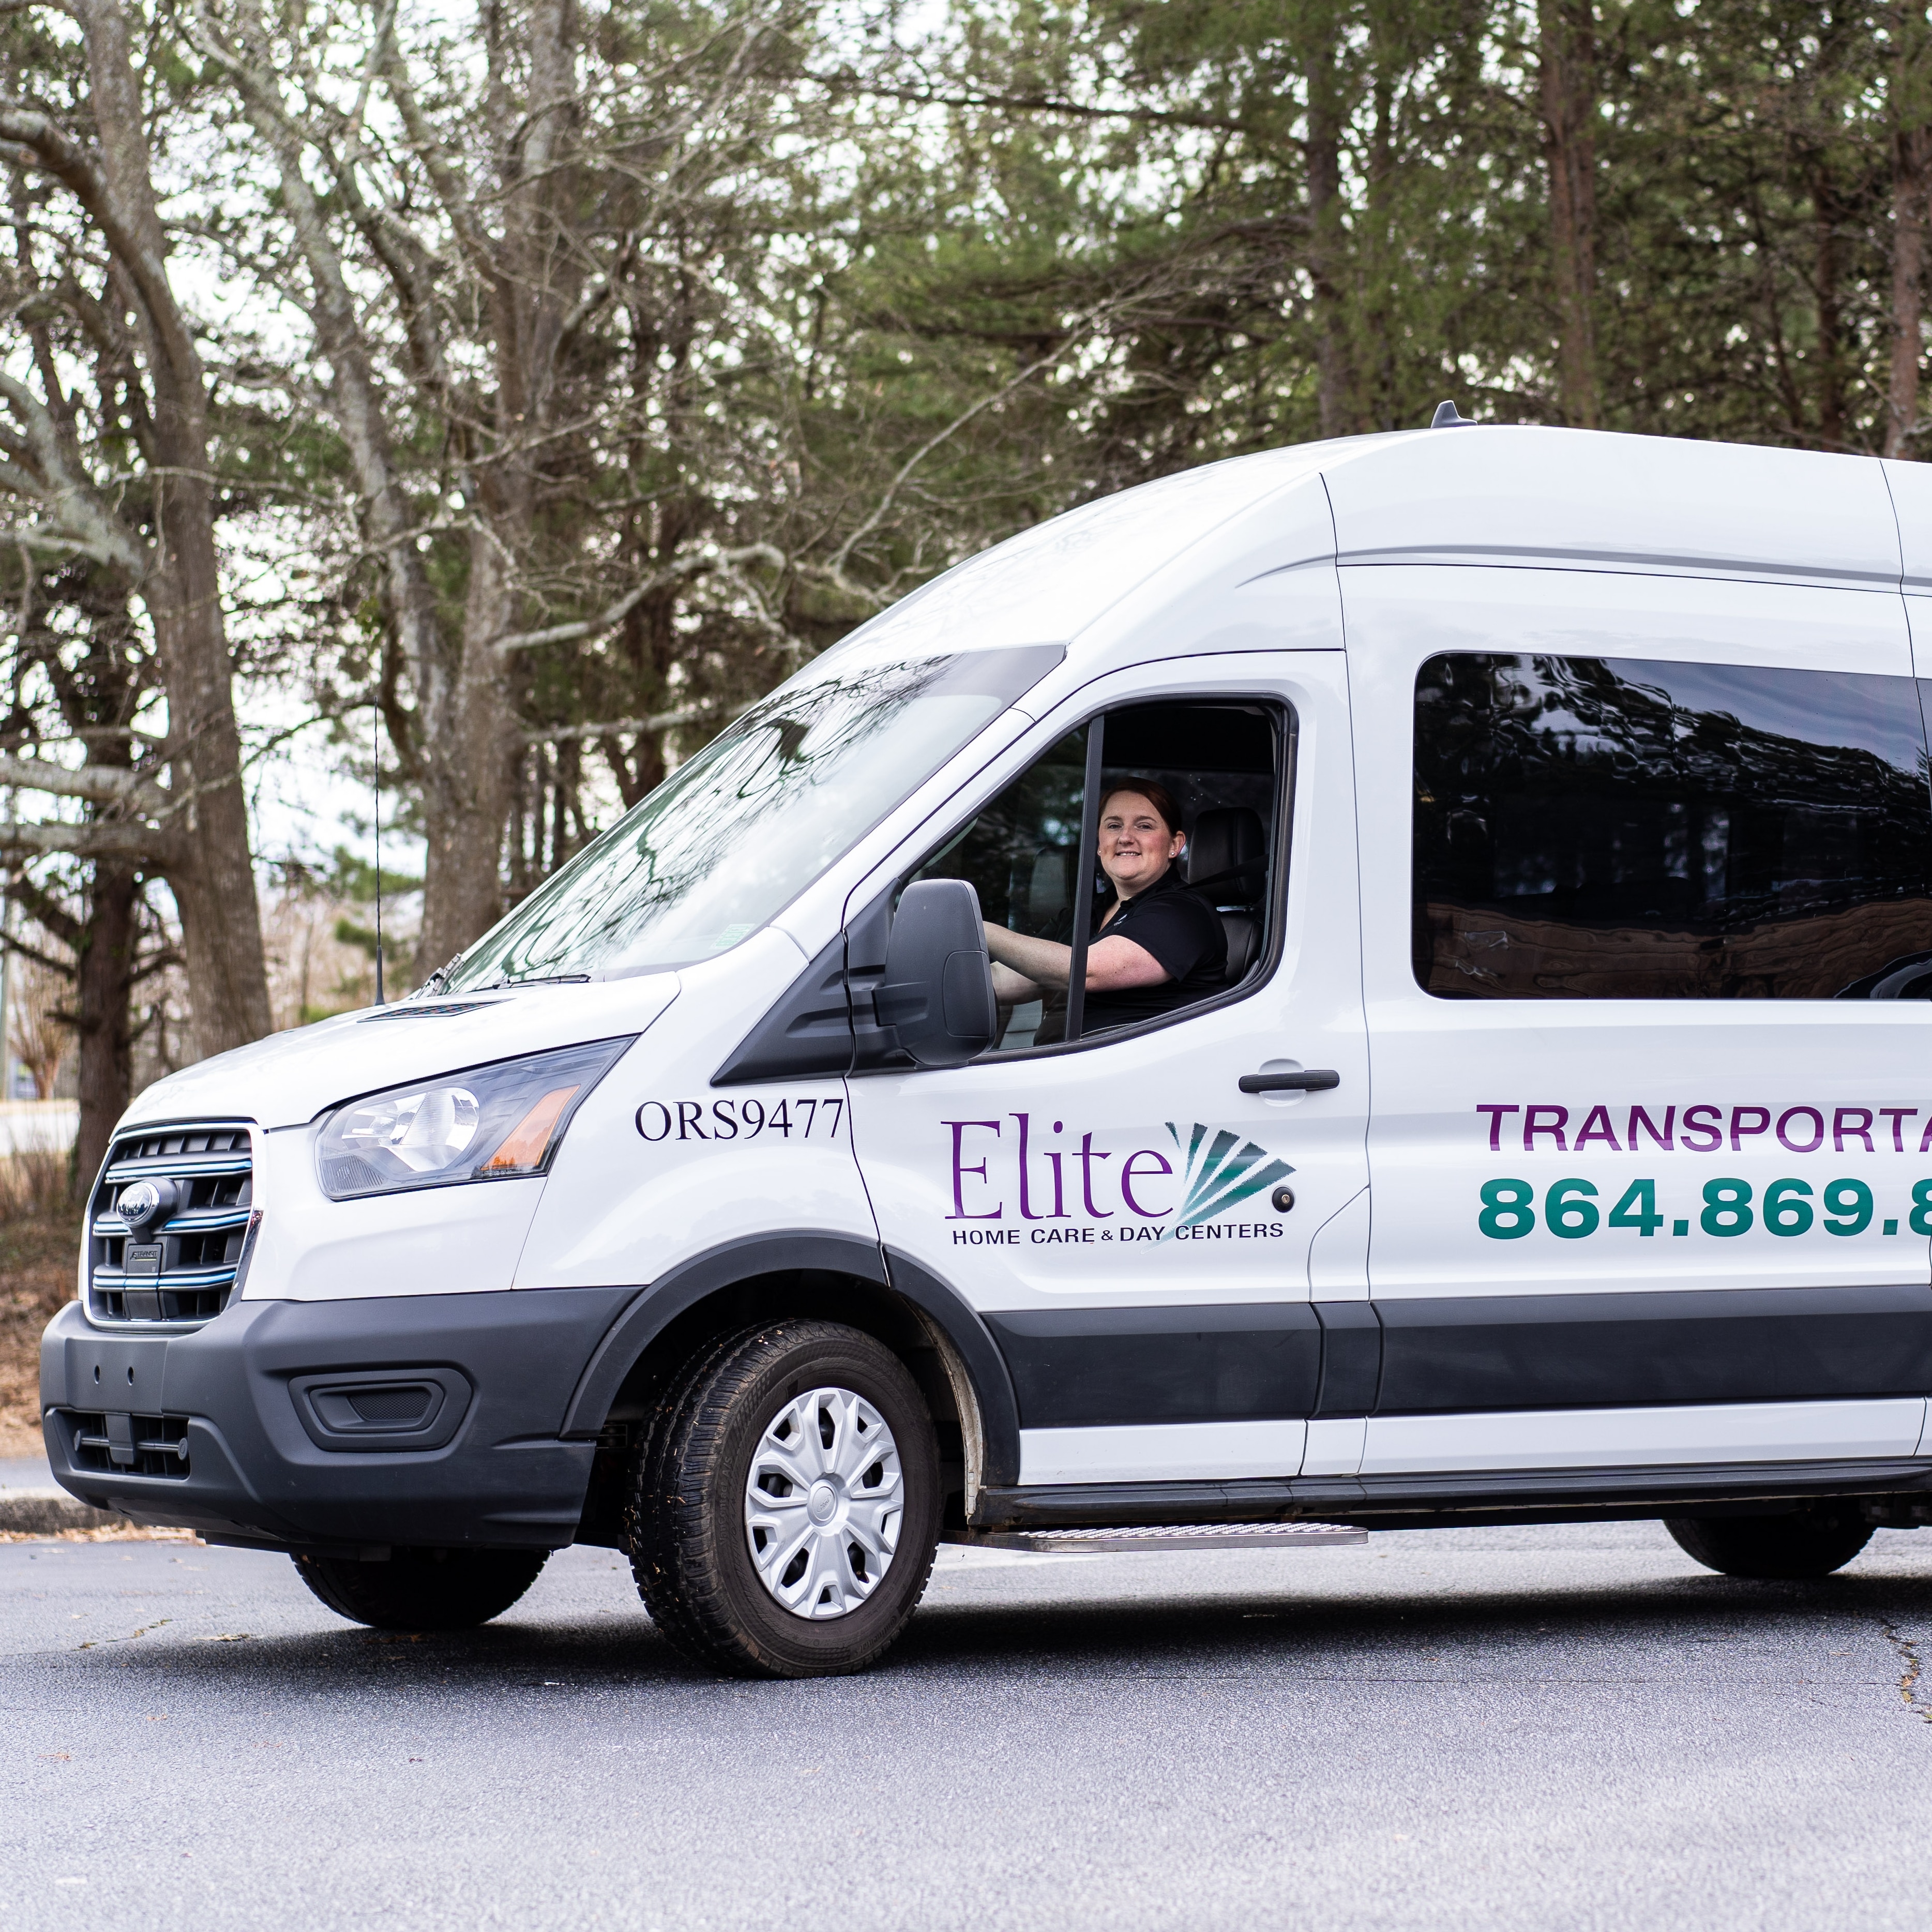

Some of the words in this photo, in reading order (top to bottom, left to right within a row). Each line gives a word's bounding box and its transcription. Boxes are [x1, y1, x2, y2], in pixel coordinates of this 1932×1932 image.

[635, 1098, 844, 1141] ORS9477
[1476, 1105, 1932, 1153] TRANSPORT
[940, 1113, 1173, 1220] Elite
[953, 1229, 1020, 1245] HOME
[1031, 1228, 1095, 1243] CARE
[1101, 1230, 1113, 1241] &
[1120, 1226, 1166, 1242] DAY
[1175, 1222, 1284, 1240] CENTERS
[718, 1482, 728, 1546] VanContact
